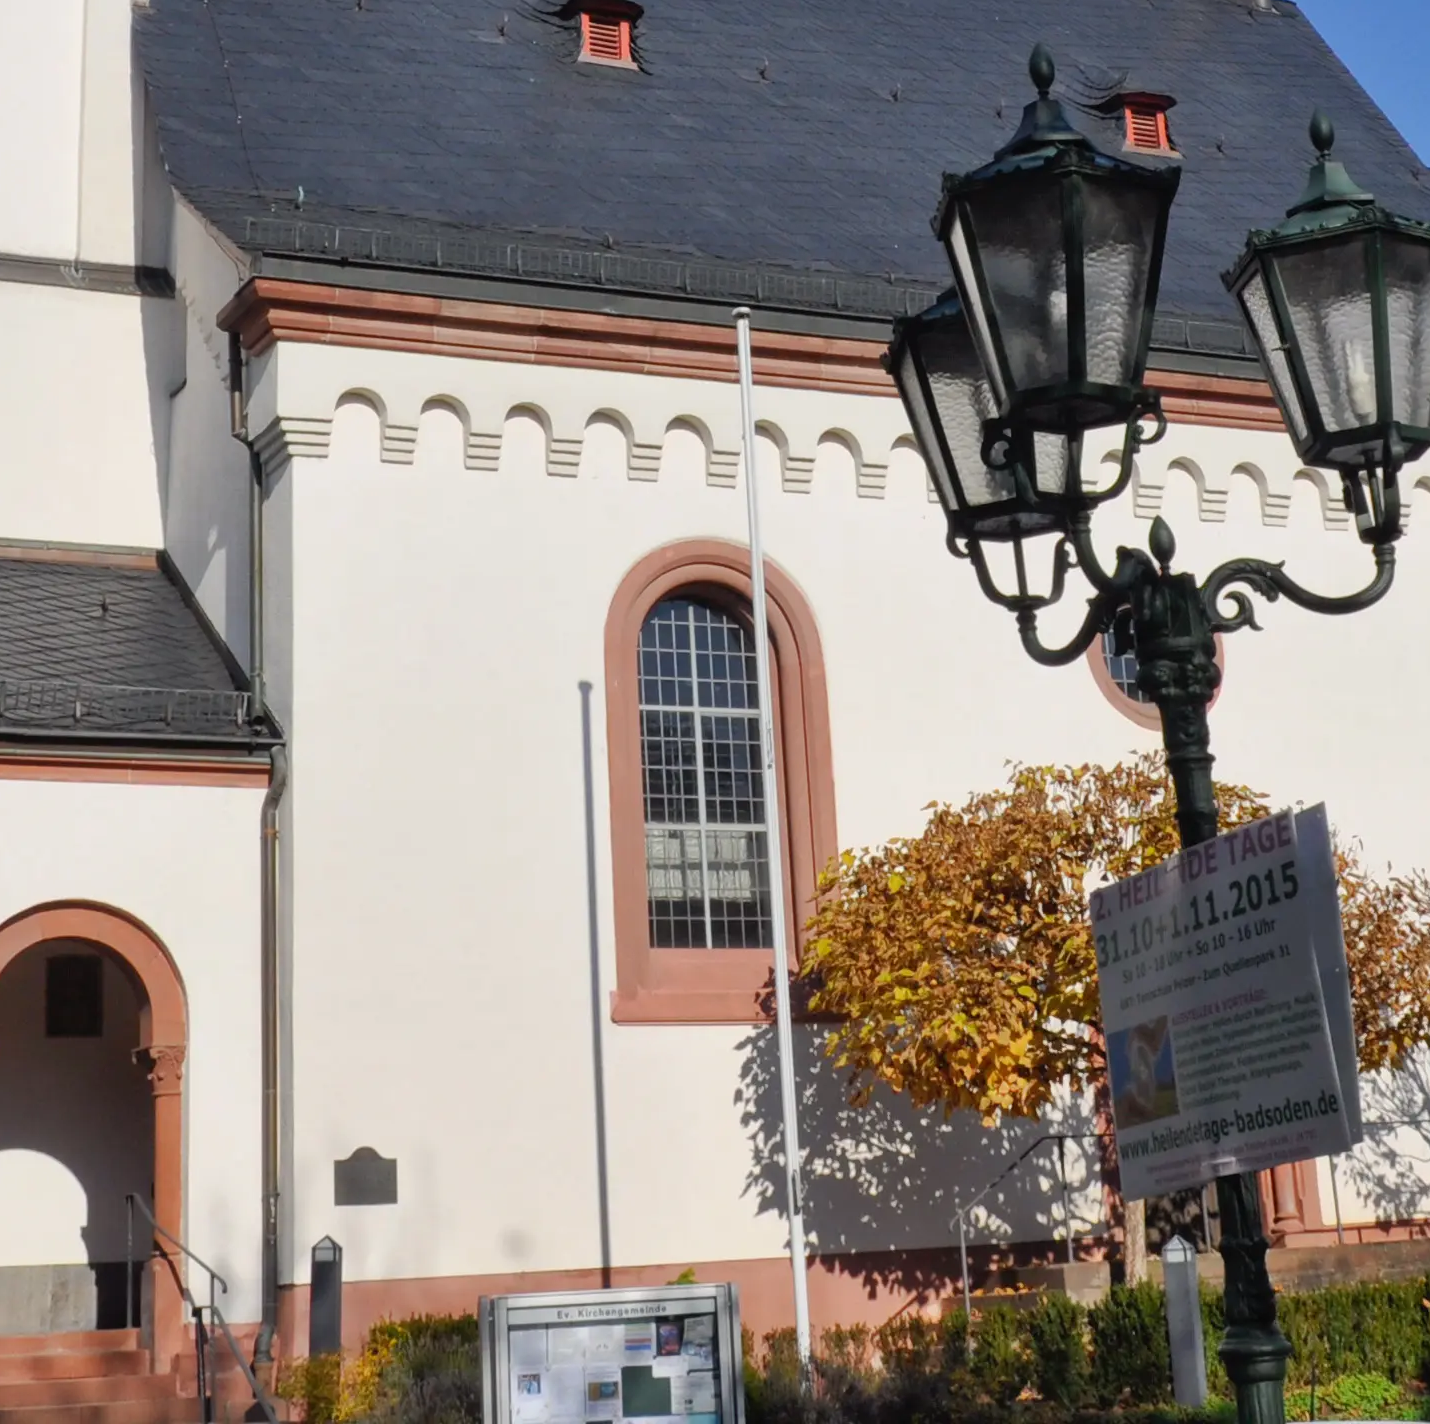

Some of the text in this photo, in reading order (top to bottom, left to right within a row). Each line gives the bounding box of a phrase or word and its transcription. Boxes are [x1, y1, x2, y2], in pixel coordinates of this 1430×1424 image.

[1093, 894, 1111, 921] 2.
[1224, 815, 1291, 865] TAGE
[1196, 940, 1209, 955] So
[1213, 934, 1225, 950] 10
[1238, 927, 1251, 942] 16
[1255, 918, 1275, 936] Uhr
[1119, 1090, 1339, 1161] www.heilendetage-badsoden.de
[577, 1304, 667, 1318] Kirchengemeinde
